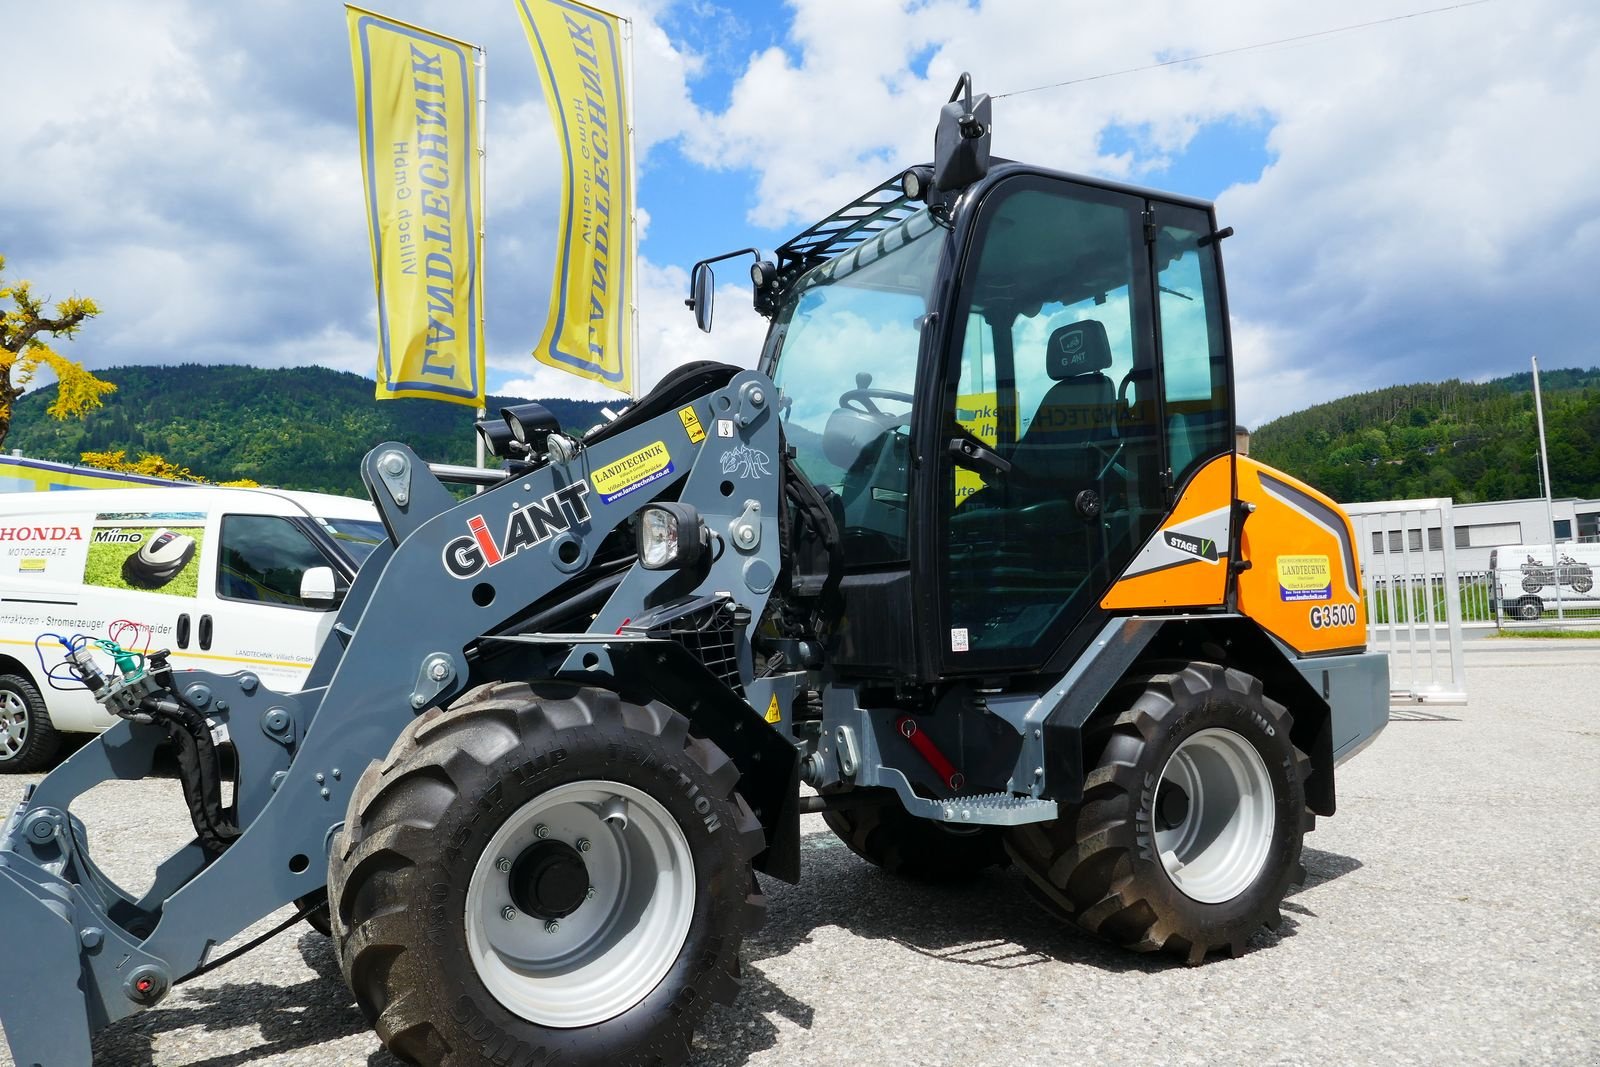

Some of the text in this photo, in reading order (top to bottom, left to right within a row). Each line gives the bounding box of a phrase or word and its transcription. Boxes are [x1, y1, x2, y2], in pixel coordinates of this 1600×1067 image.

[1061, 351, 1086, 366] GANT
[594, 445, 663, 483] LANDTECHNIK
[607, 468, 670, 502] www.landtechnik.co.at
[607, 480, 626, 492] Villach
[0, 527, 83, 541] HONDA
[94, 528, 143, 543] Miimo
[442, 479, 592, 580] GIANT
[1170, 537, 1214, 556] STAGE V
[1281, 564, 1327, 576] LANDTECHNIK
[46, 615, 106, 630] Stromerzeuger
[1309, 603, 1357, 631] G3500
[235, 649, 272, 659] LANDTECHNIK
